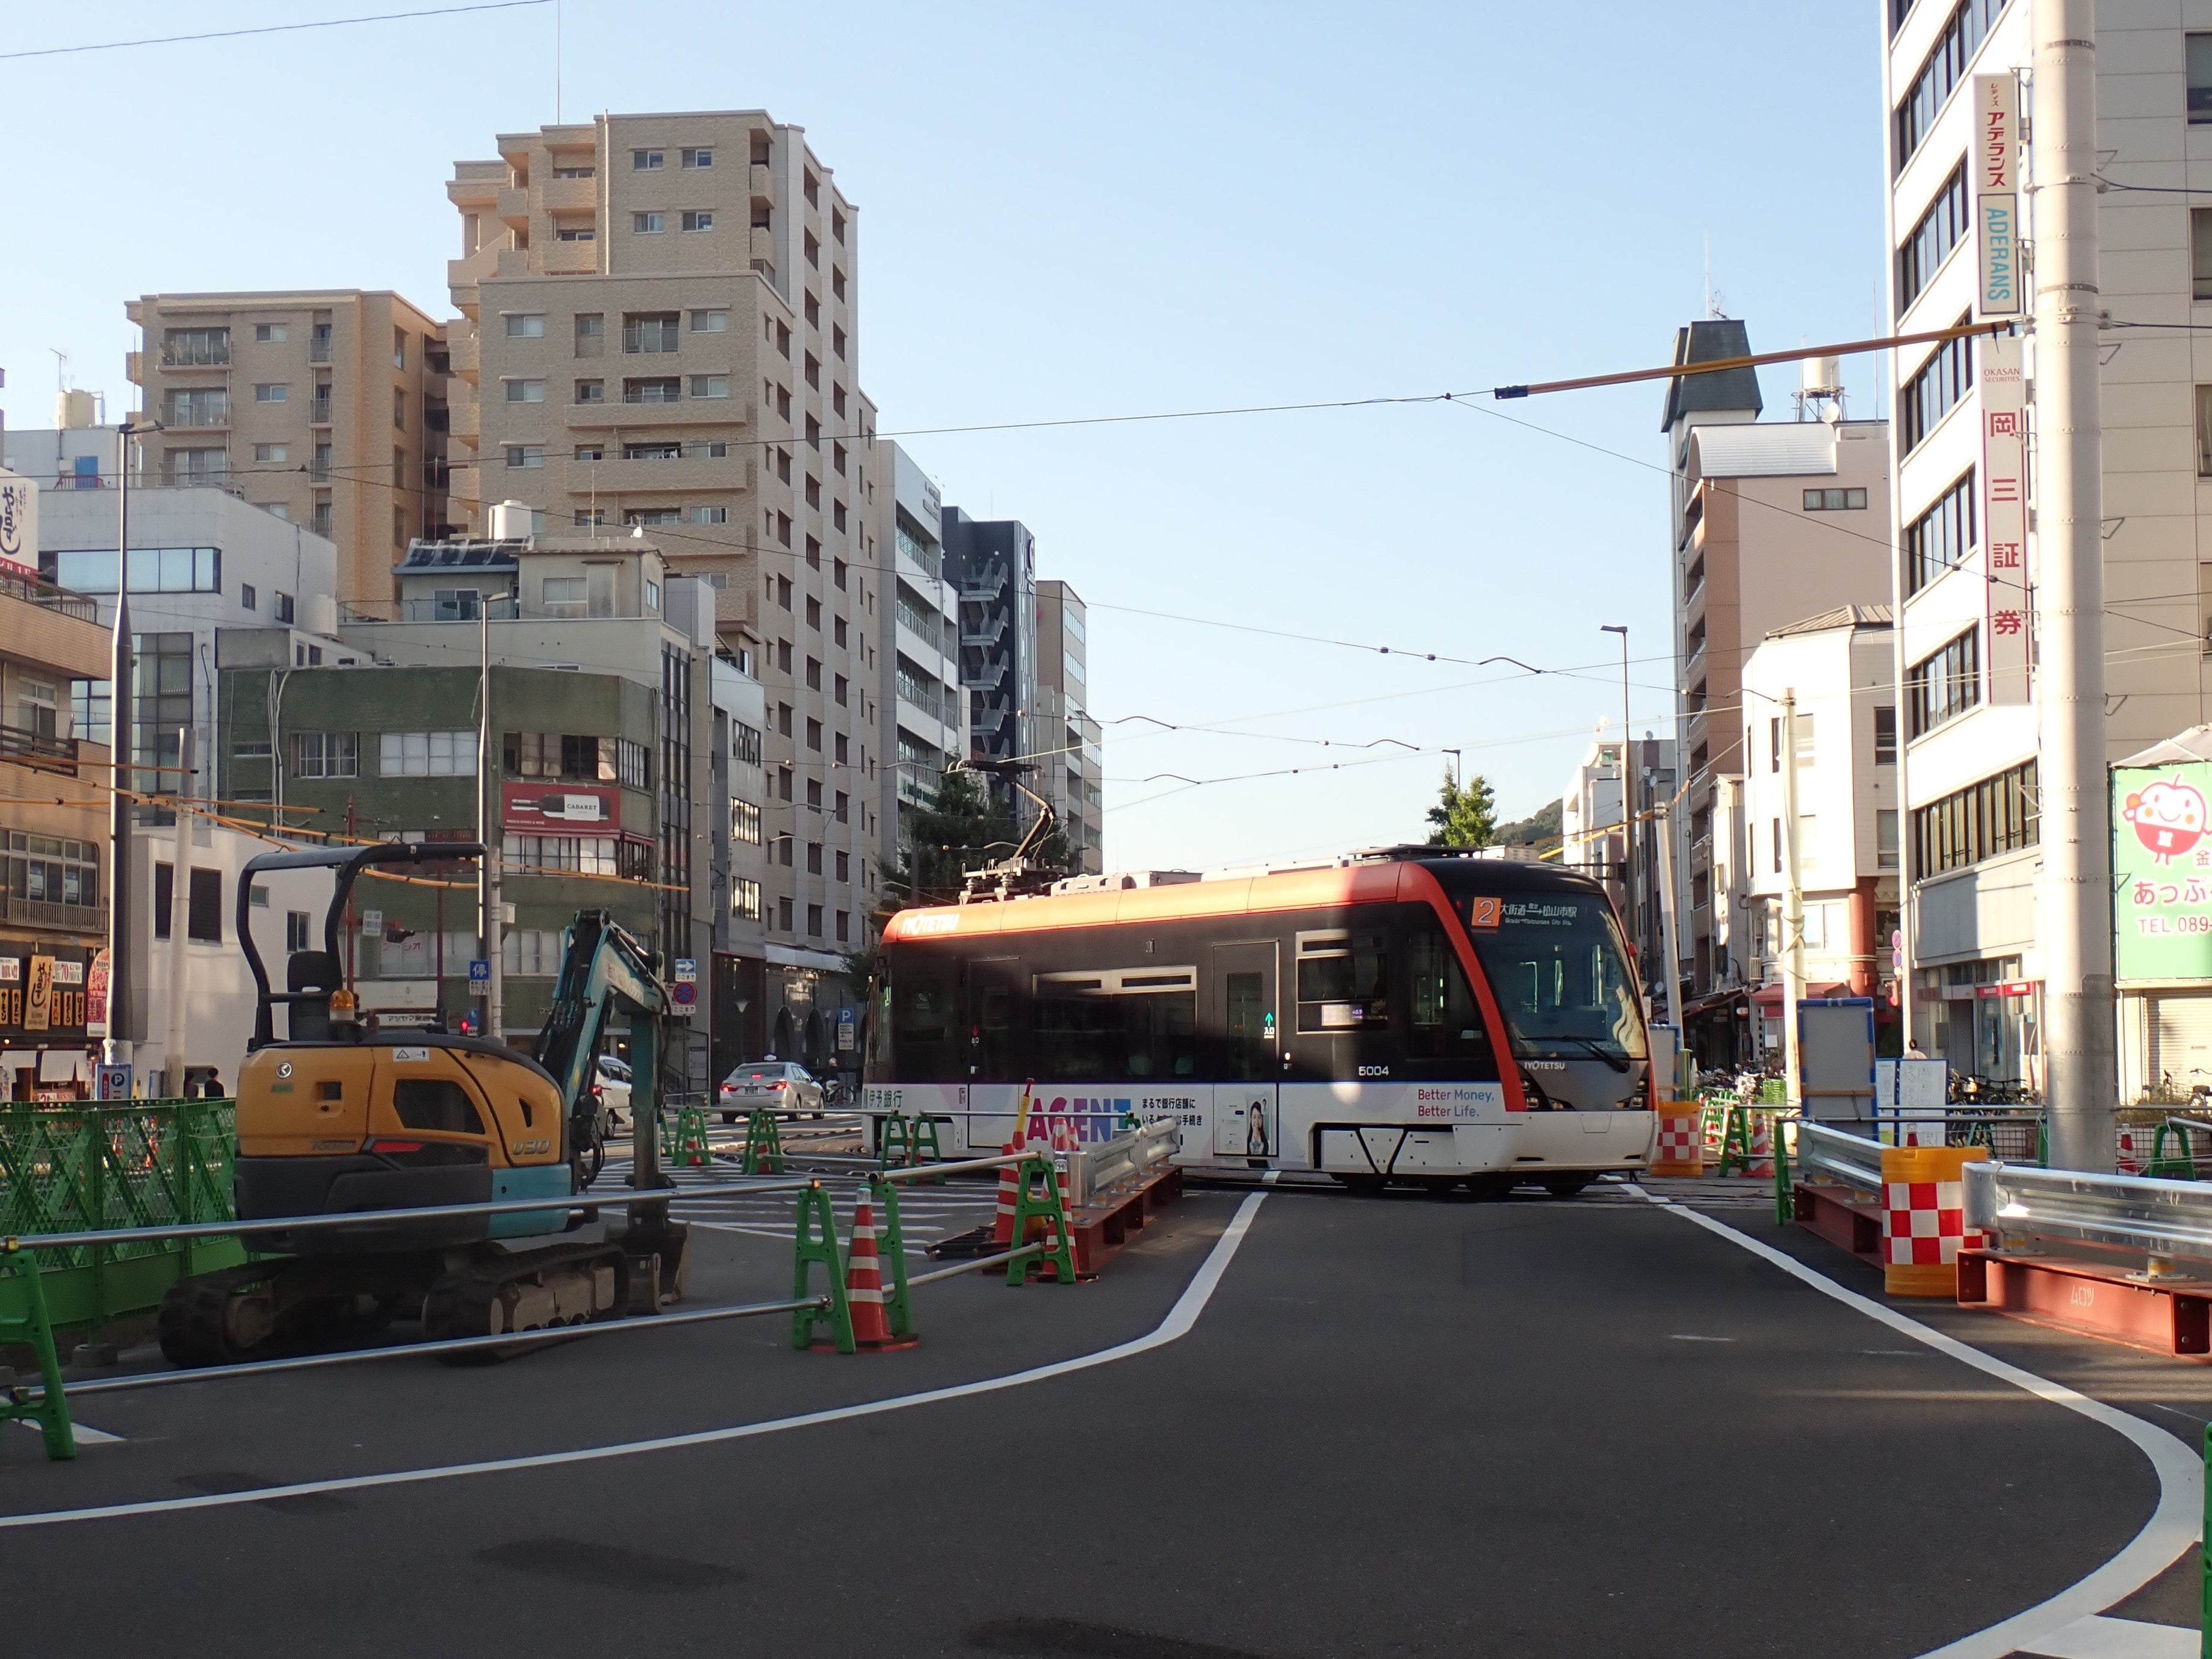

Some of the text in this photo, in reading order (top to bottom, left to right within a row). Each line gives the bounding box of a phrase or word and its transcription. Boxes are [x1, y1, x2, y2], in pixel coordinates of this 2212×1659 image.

[1987, 111, 2006, 187] アデランス
[1986, 207, 2010, 301] ADERANS
[1990, 412, 2022, 635] 岡三証券
[2134, 877, 2212, 905] あっぷ
[1478, 899, 1495, 924] 2
[1500, 903, 1526, 916] 大街道
[1542, 904, 1578, 918] 松山市駅
[2138, 918, 2170, 933] TEL
[842, 1010, 851, 1022] P
[1264, 1027, 1275, 1035] 入口
[1525, 1061, 1566, 1070] IYOTETSU
[869, 1090, 902, 1108] 伊予銀行
[1142, 1098, 1196, 1109] まるで銀行店舗に
[1418, 1089, 1495, 1103] Better Money,
[1418, 1105, 1479, 1117] Better Life.
[1026, 1096, 1131, 1143] AGENT
